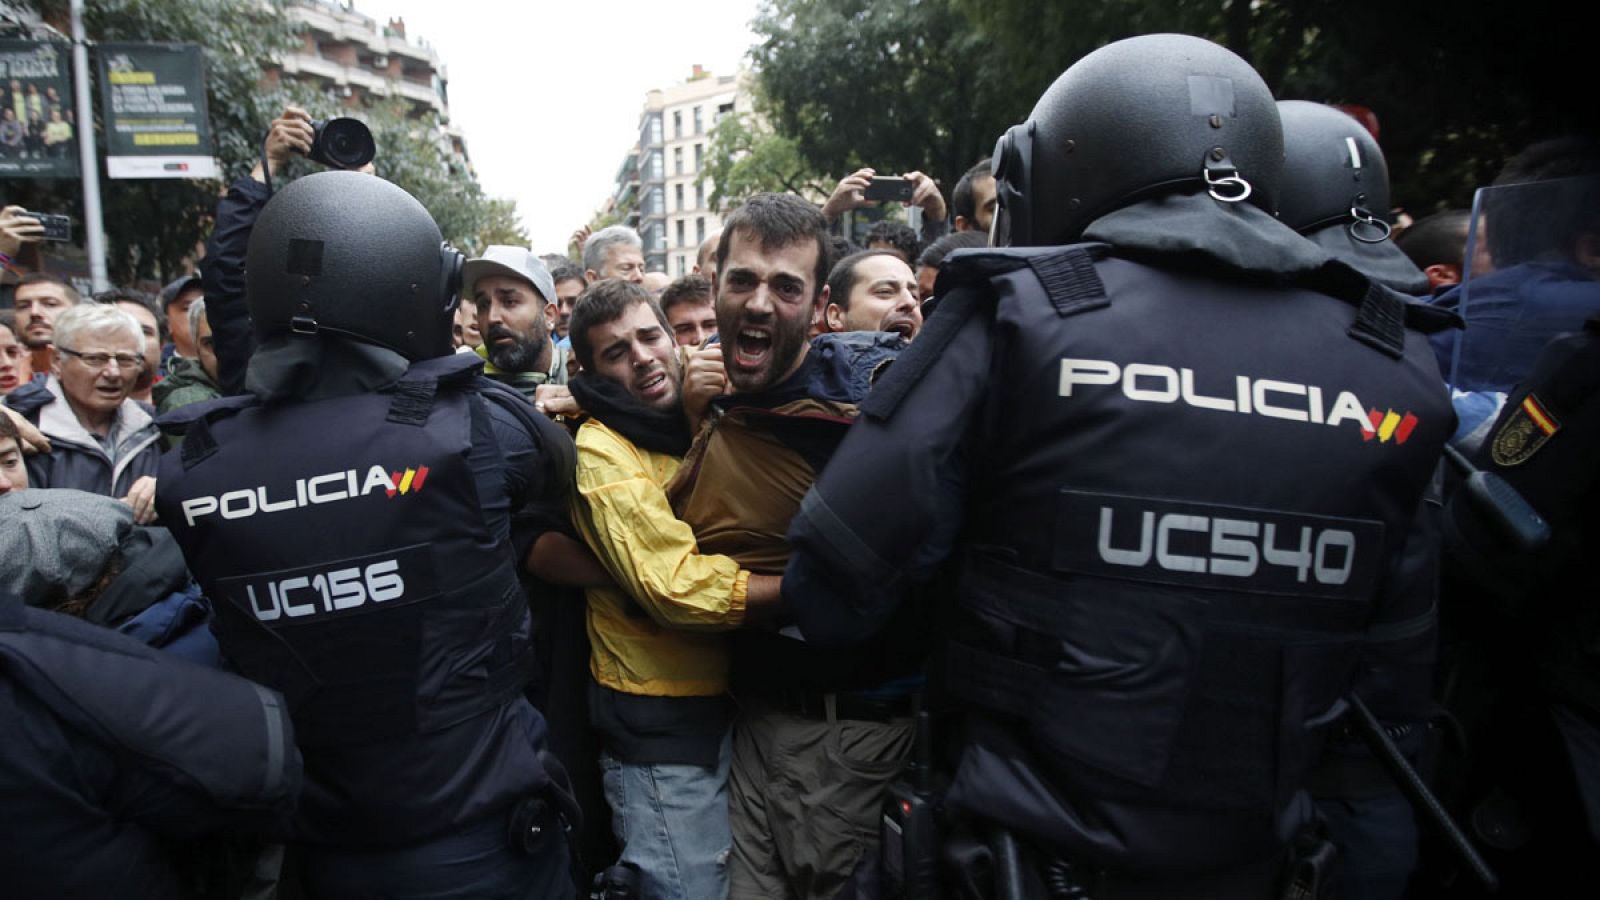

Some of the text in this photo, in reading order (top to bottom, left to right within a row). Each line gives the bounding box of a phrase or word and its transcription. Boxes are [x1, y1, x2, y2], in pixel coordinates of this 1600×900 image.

[1058, 358, 1376, 432] POLICIA
[181, 465, 396, 527] POLICIA
[1098, 507, 1355, 585] UC540
[246, 559, 404, 621] UC156
